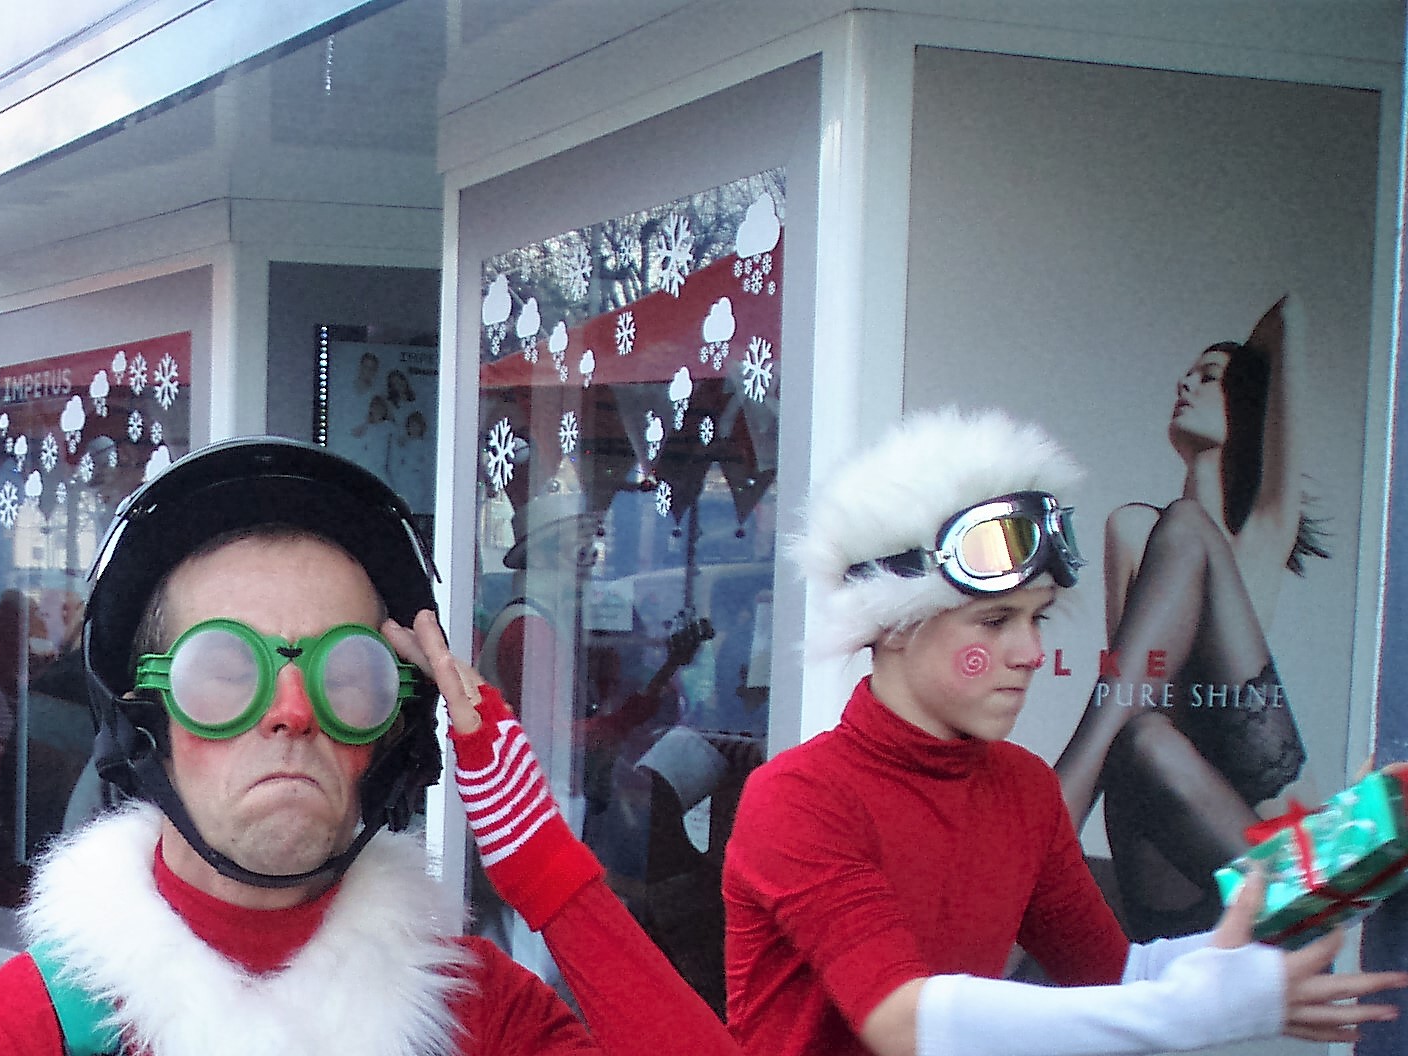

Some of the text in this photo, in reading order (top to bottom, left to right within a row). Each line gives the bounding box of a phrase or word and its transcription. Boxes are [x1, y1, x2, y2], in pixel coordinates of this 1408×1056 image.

[1, 368, 71, 402] IMPETUS
[1095, 682, 1286, 709] PURE SHINE
